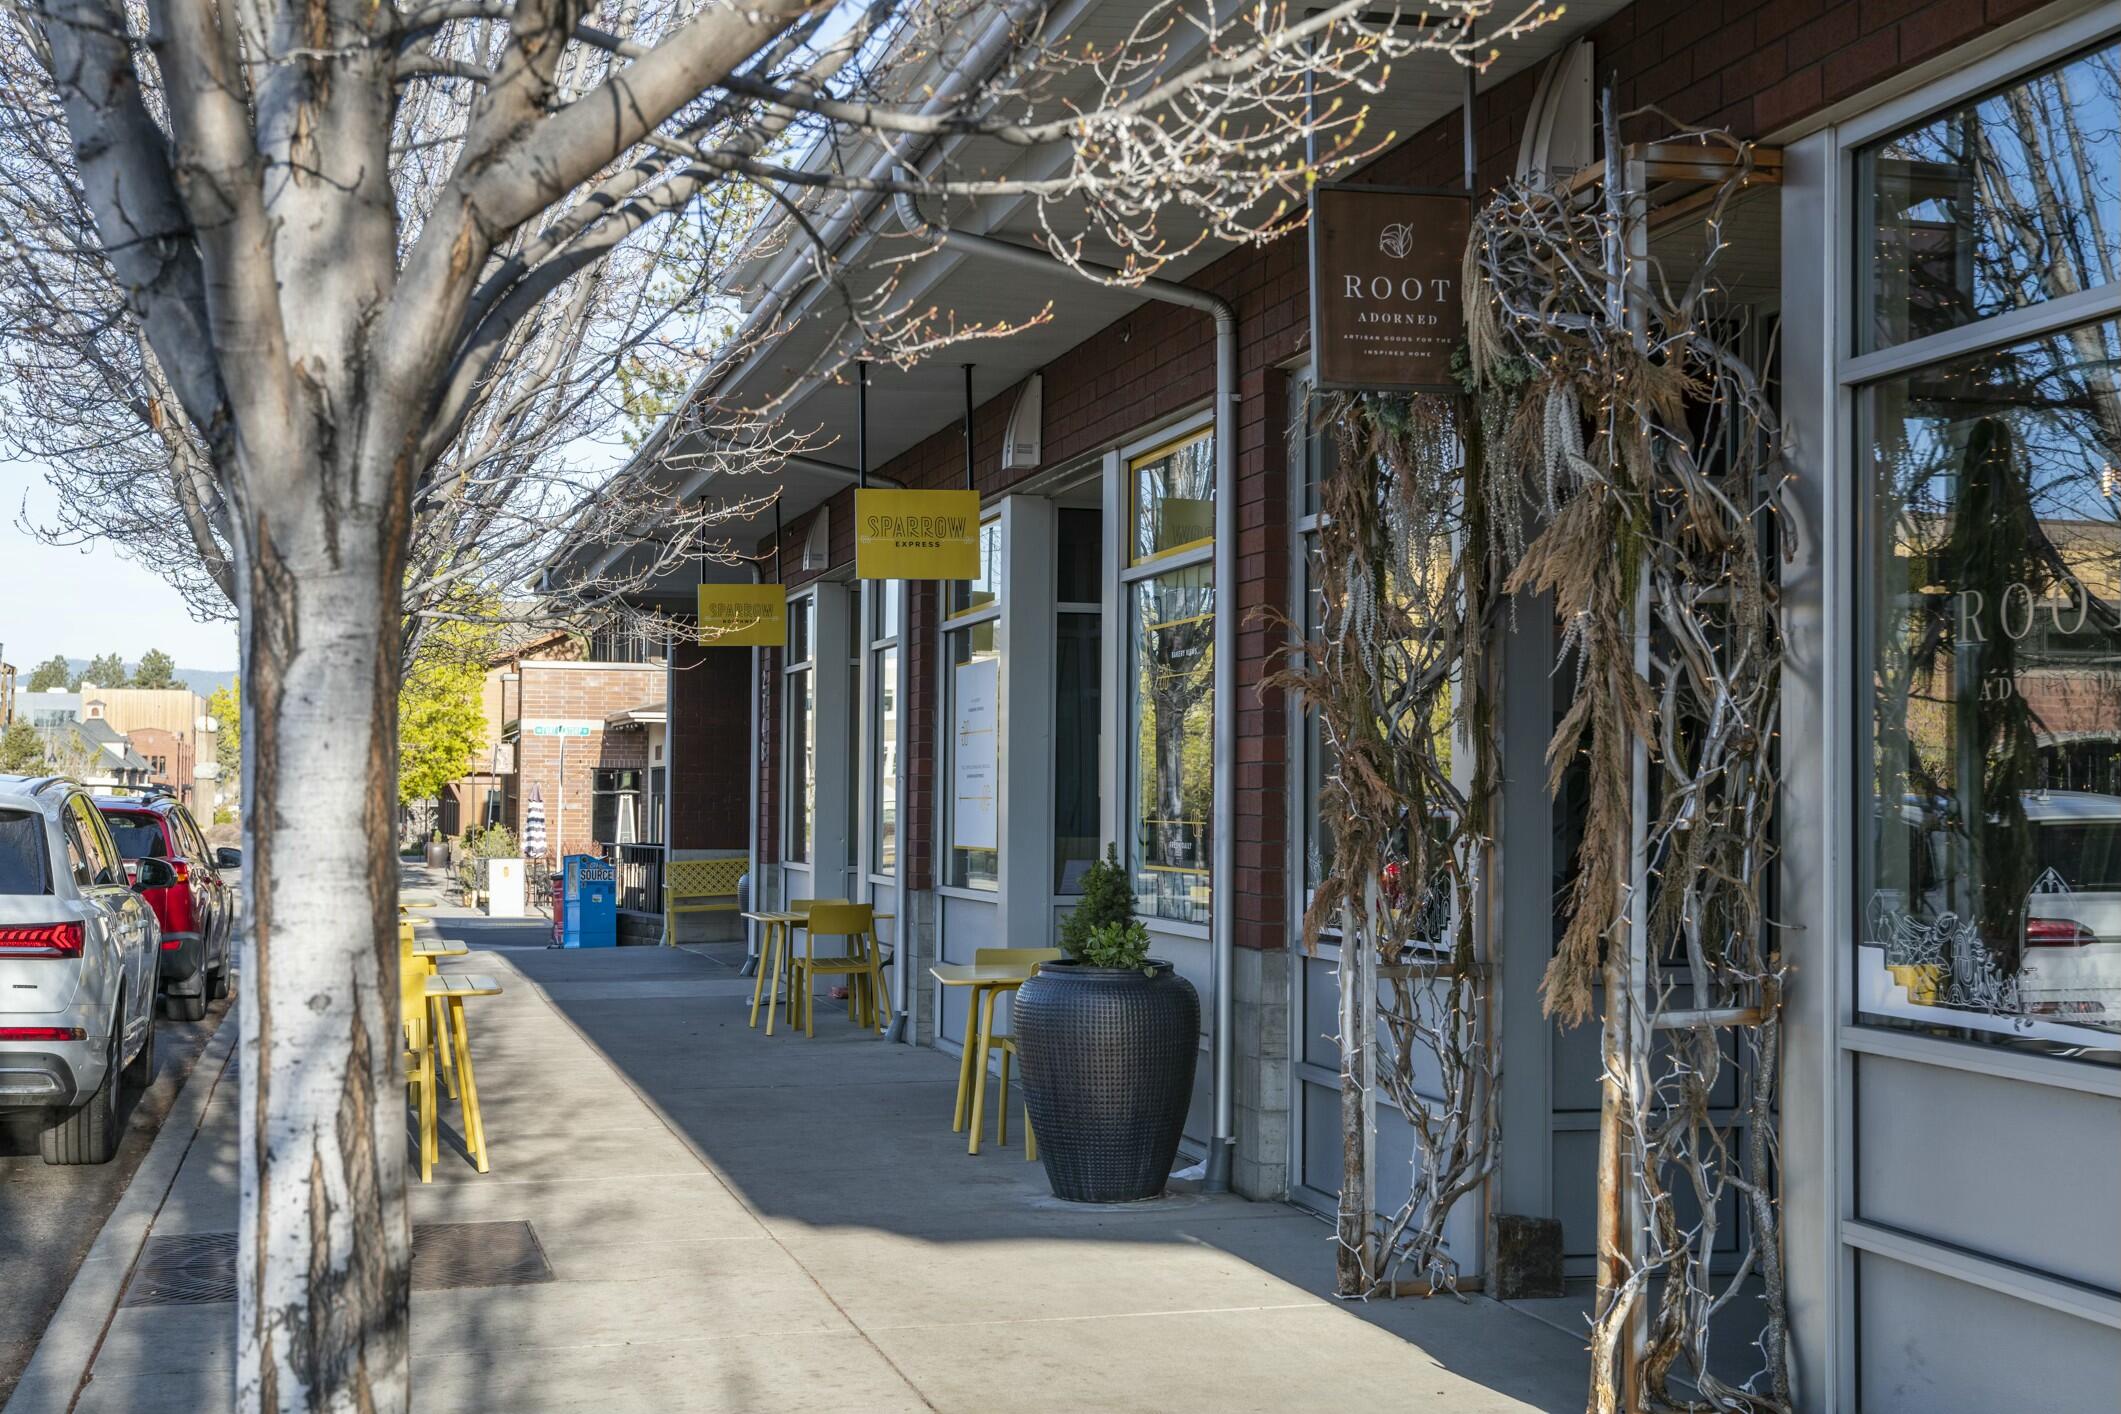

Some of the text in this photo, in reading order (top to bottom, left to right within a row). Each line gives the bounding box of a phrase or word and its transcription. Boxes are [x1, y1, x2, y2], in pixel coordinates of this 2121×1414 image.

[1343, 275, 1450, 302] ROOT
[1358, 312, 1437, 325] ADORNED
[867, 515, 966, 539] SPARROW
[709, 602, 775, 617] SPARROW
[1957, 576, 2121, 643] ROO
[580, 869, 613, 880] SOURCE
